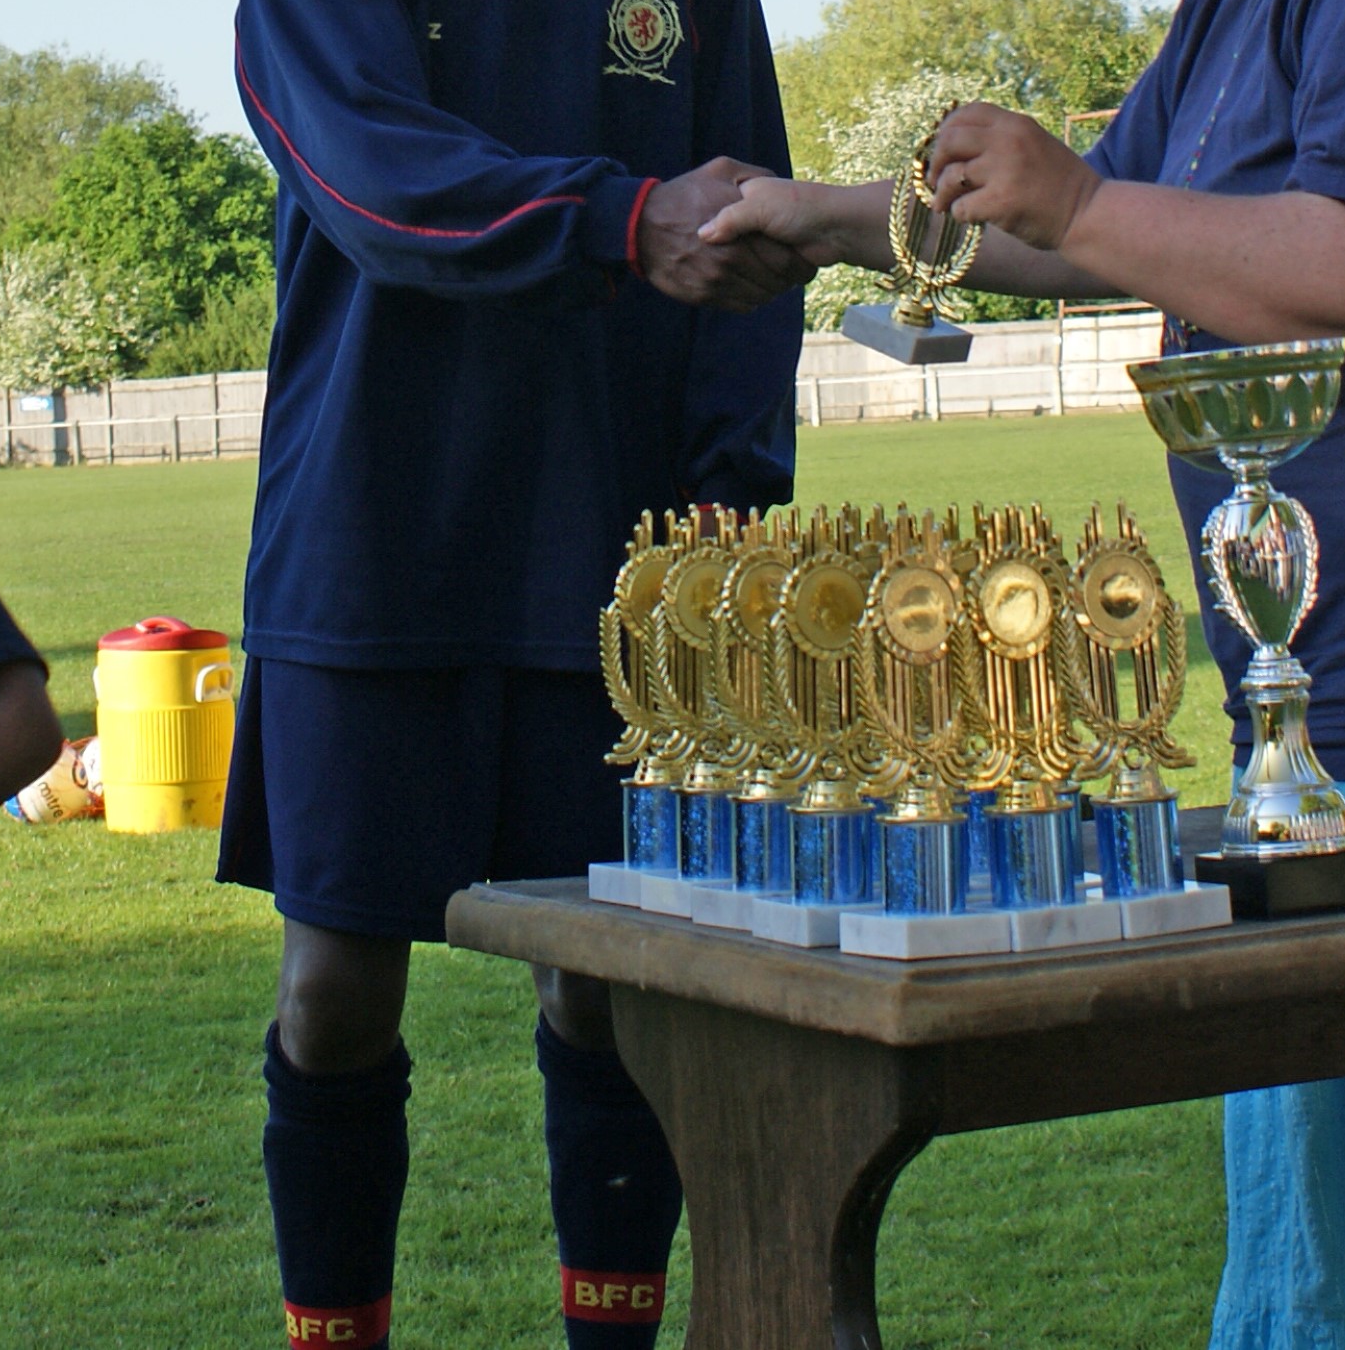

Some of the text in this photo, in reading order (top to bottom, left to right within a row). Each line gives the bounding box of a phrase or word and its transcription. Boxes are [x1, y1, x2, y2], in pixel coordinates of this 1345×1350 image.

[37, 781, 64, 818] mitre
[575, 1280, 655, 1310] BFC
[286, 1309, 355, 1342] BFC
